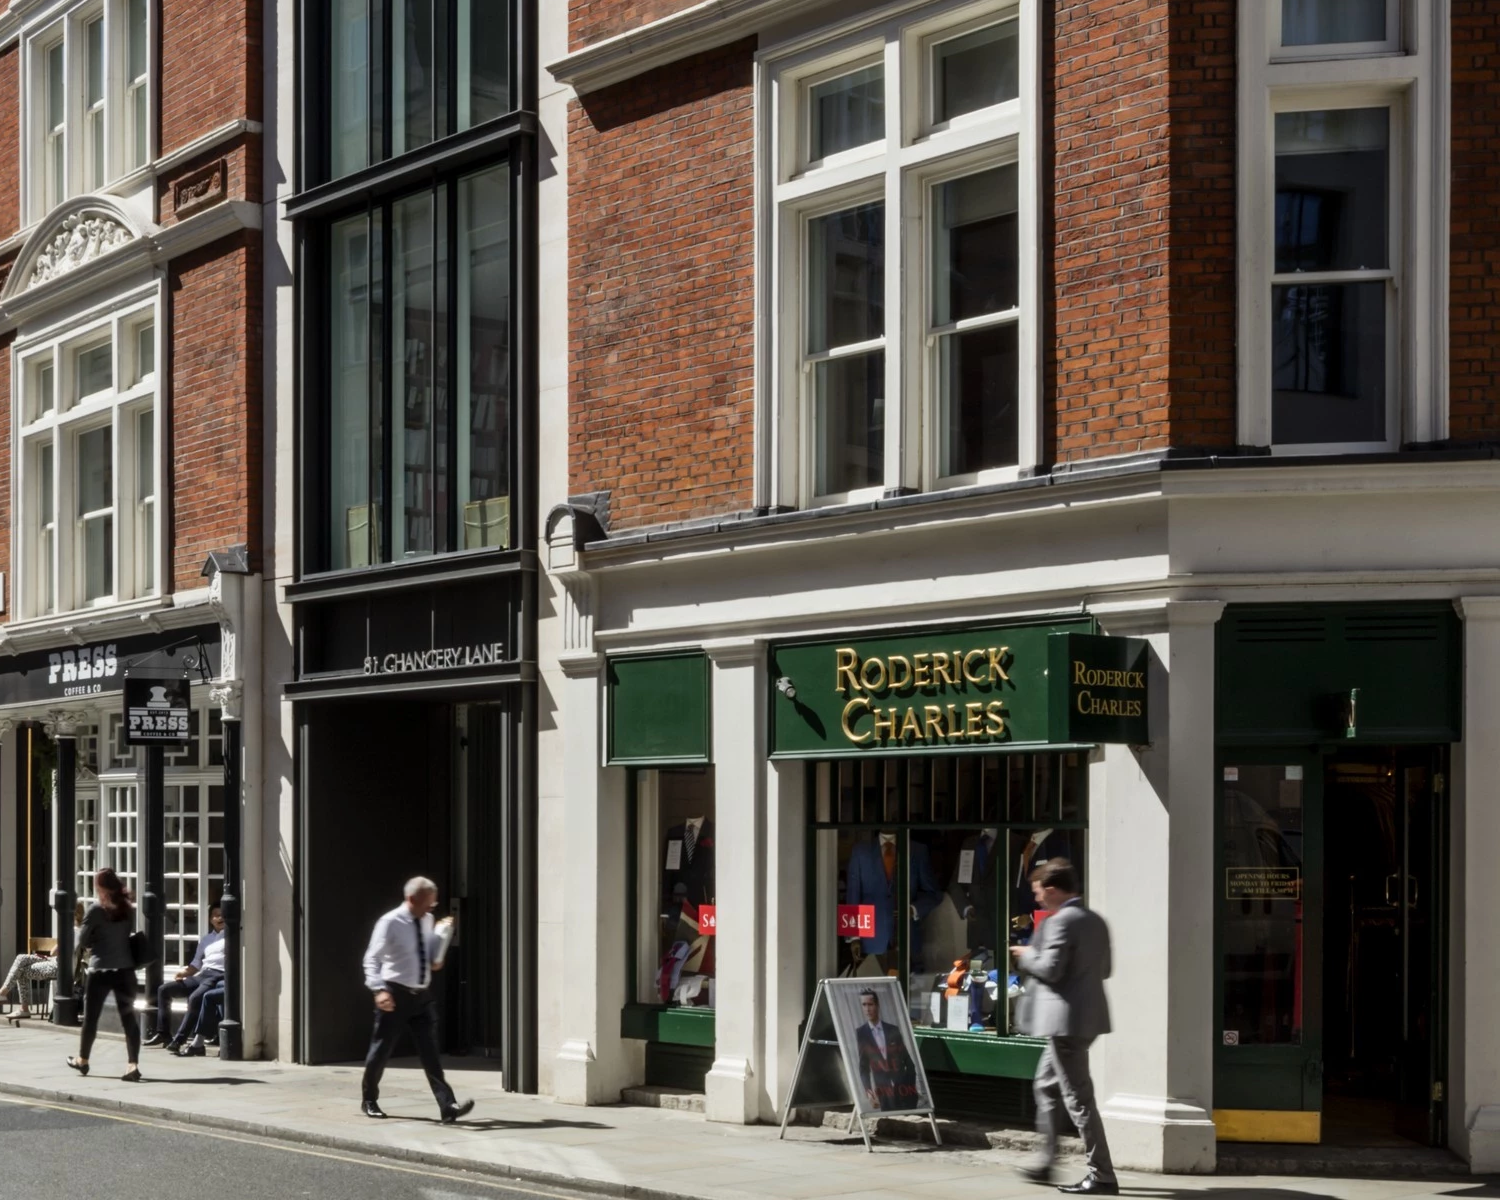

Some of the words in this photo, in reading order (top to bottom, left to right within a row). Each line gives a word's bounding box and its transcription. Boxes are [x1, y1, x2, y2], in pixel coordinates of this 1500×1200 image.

[48, 644, 117, 684] PRESS
[363, 656, 378, 675] 81
[383, 647, 463, 673] CHANCERY
[465, 643, 503, 666] LANE
[835, 646, 1009, 691] RODERICK
[1073, 660, 1145, 688] RODERICK
[64, 686, 86, 696] COFFEE
[87, 685, 91, 693] &
[93, 684, 102, 693] CO
[1077, 690, 1142, 716] CHARLES
[129, 716, 189, 731] PRESS
[841, 696, 1005, 742] CHARLES
